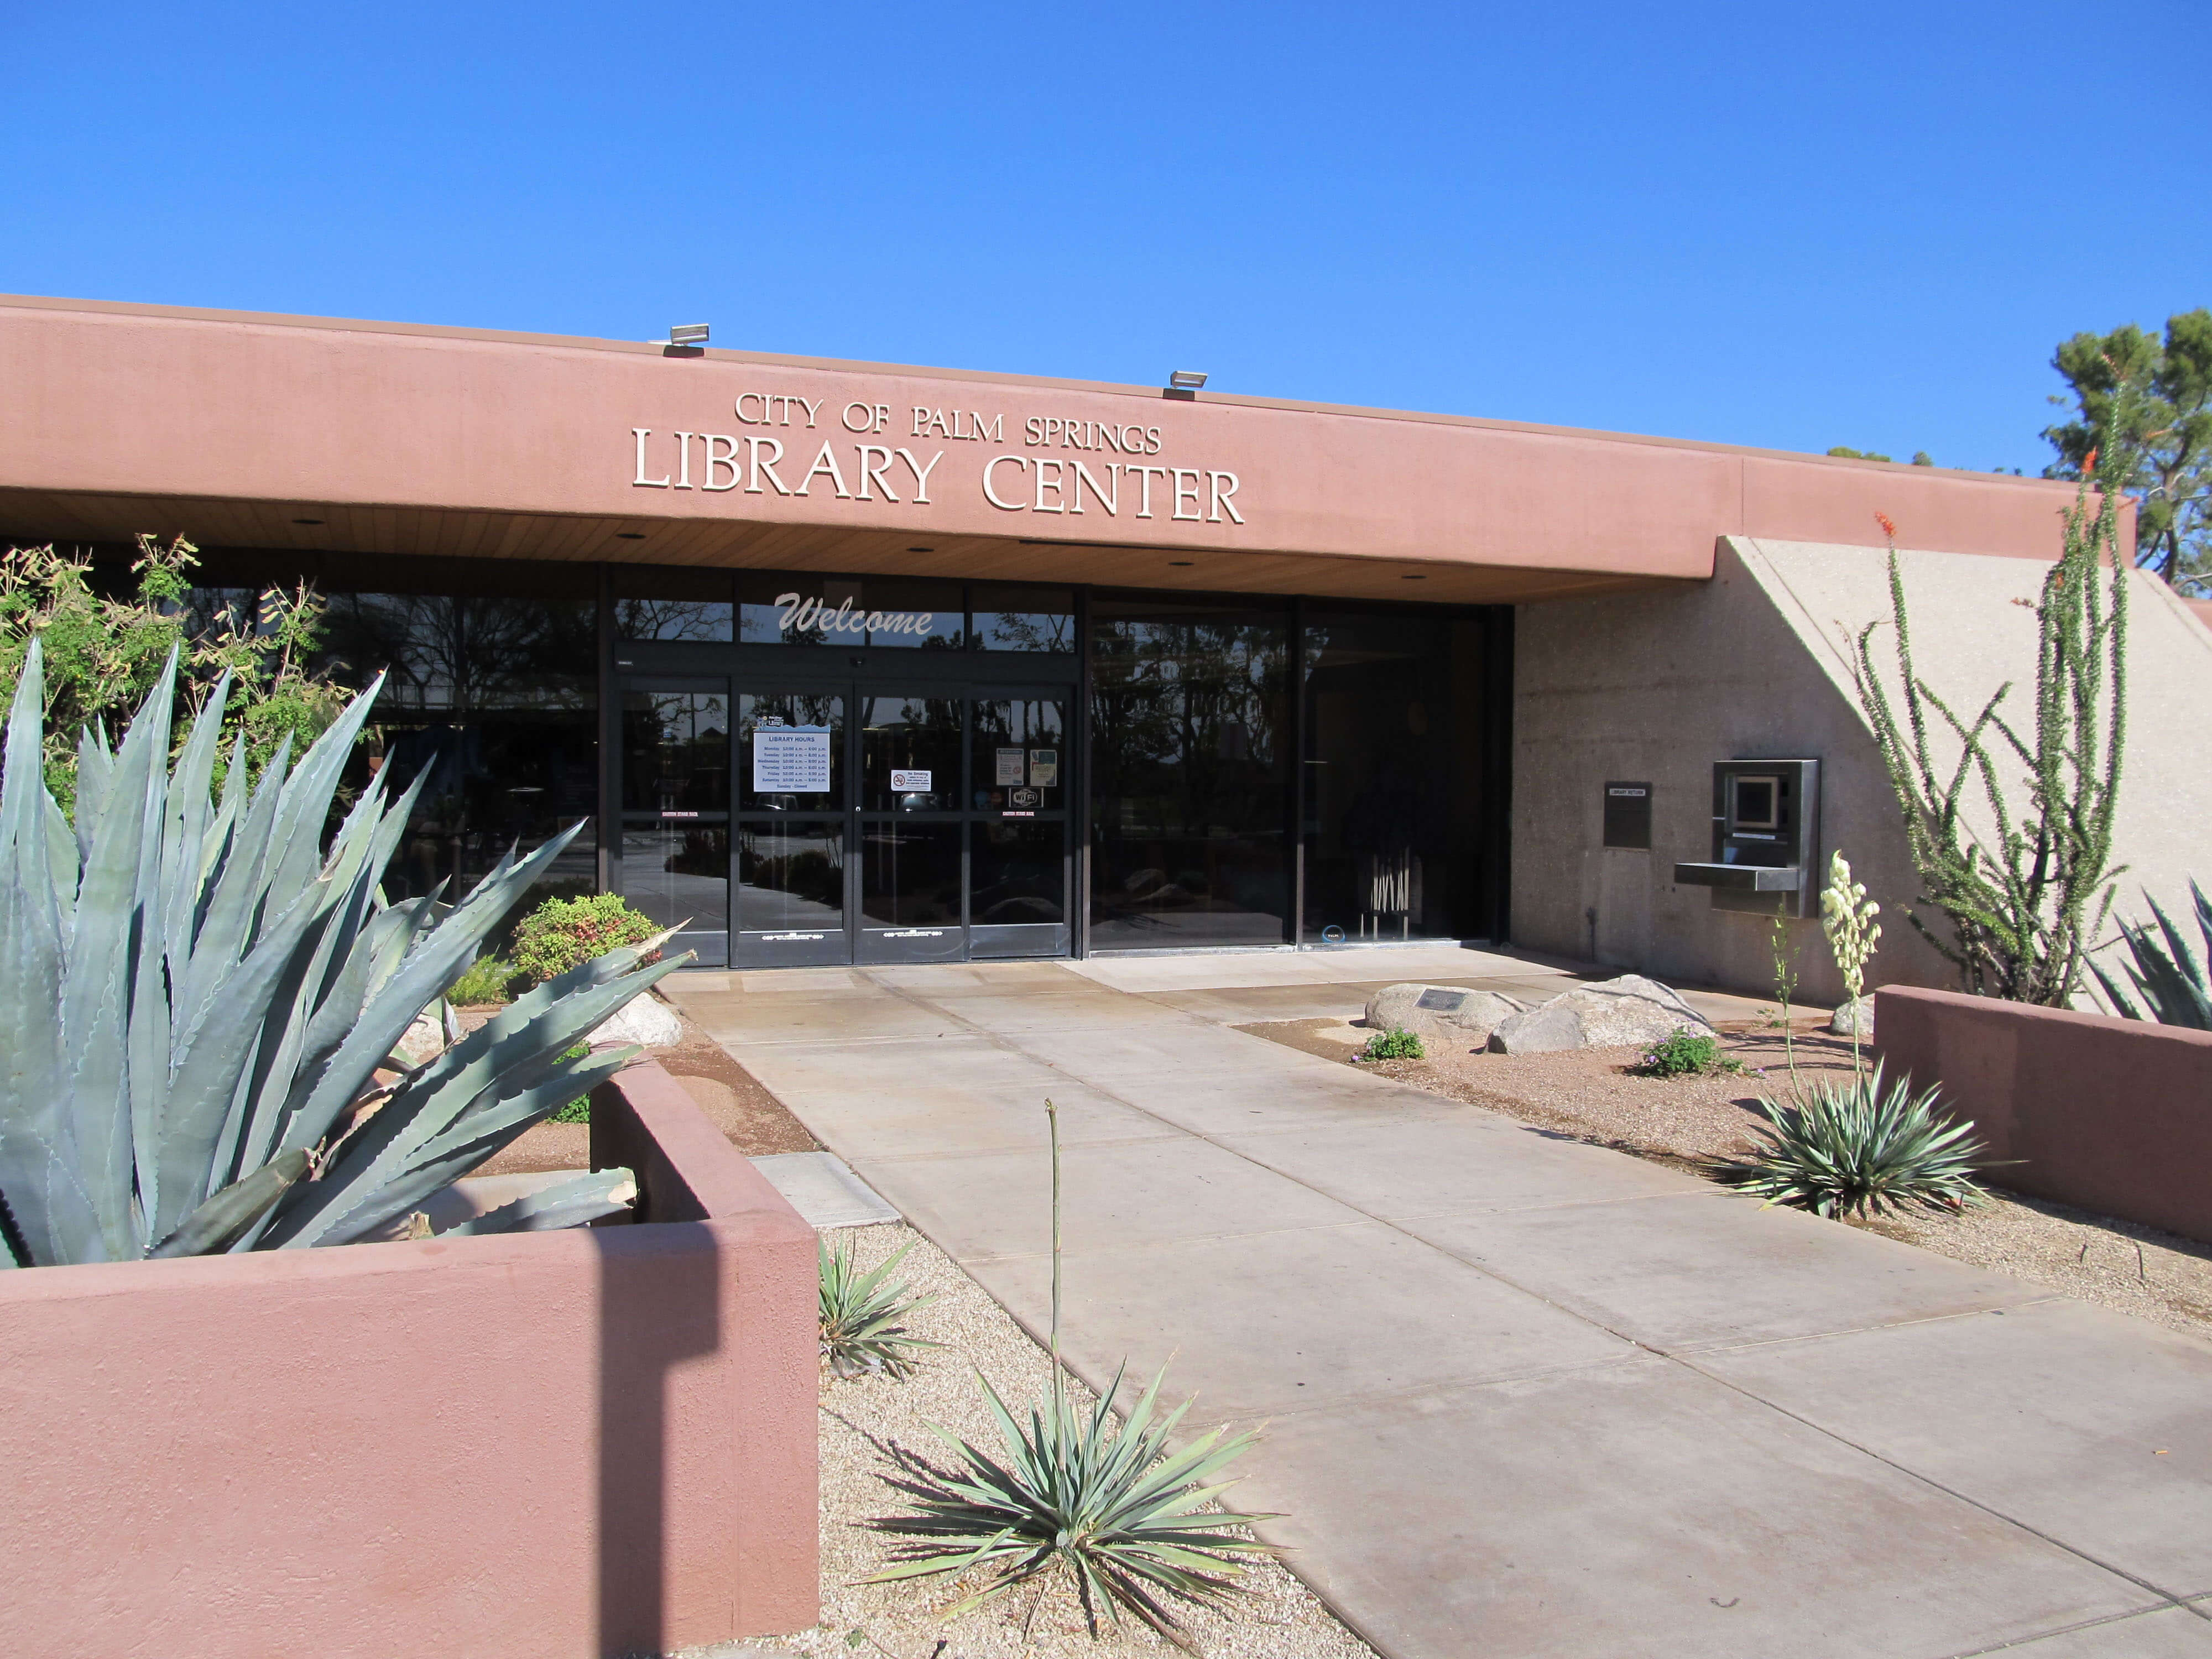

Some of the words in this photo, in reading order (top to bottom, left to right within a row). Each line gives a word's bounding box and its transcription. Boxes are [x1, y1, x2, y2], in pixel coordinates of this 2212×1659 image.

[735, 392, 823, 429] CITY
[842, 402, 890, 435] OF
[911, 405, 1004, 444] PALM
[1024, 416, 1163, 456] SPRINGS
[632, 427, 945, 504] LIBRARY
[982, 455, 1245, 524] CENTER
[774, 592, 932, 635] Welcome
